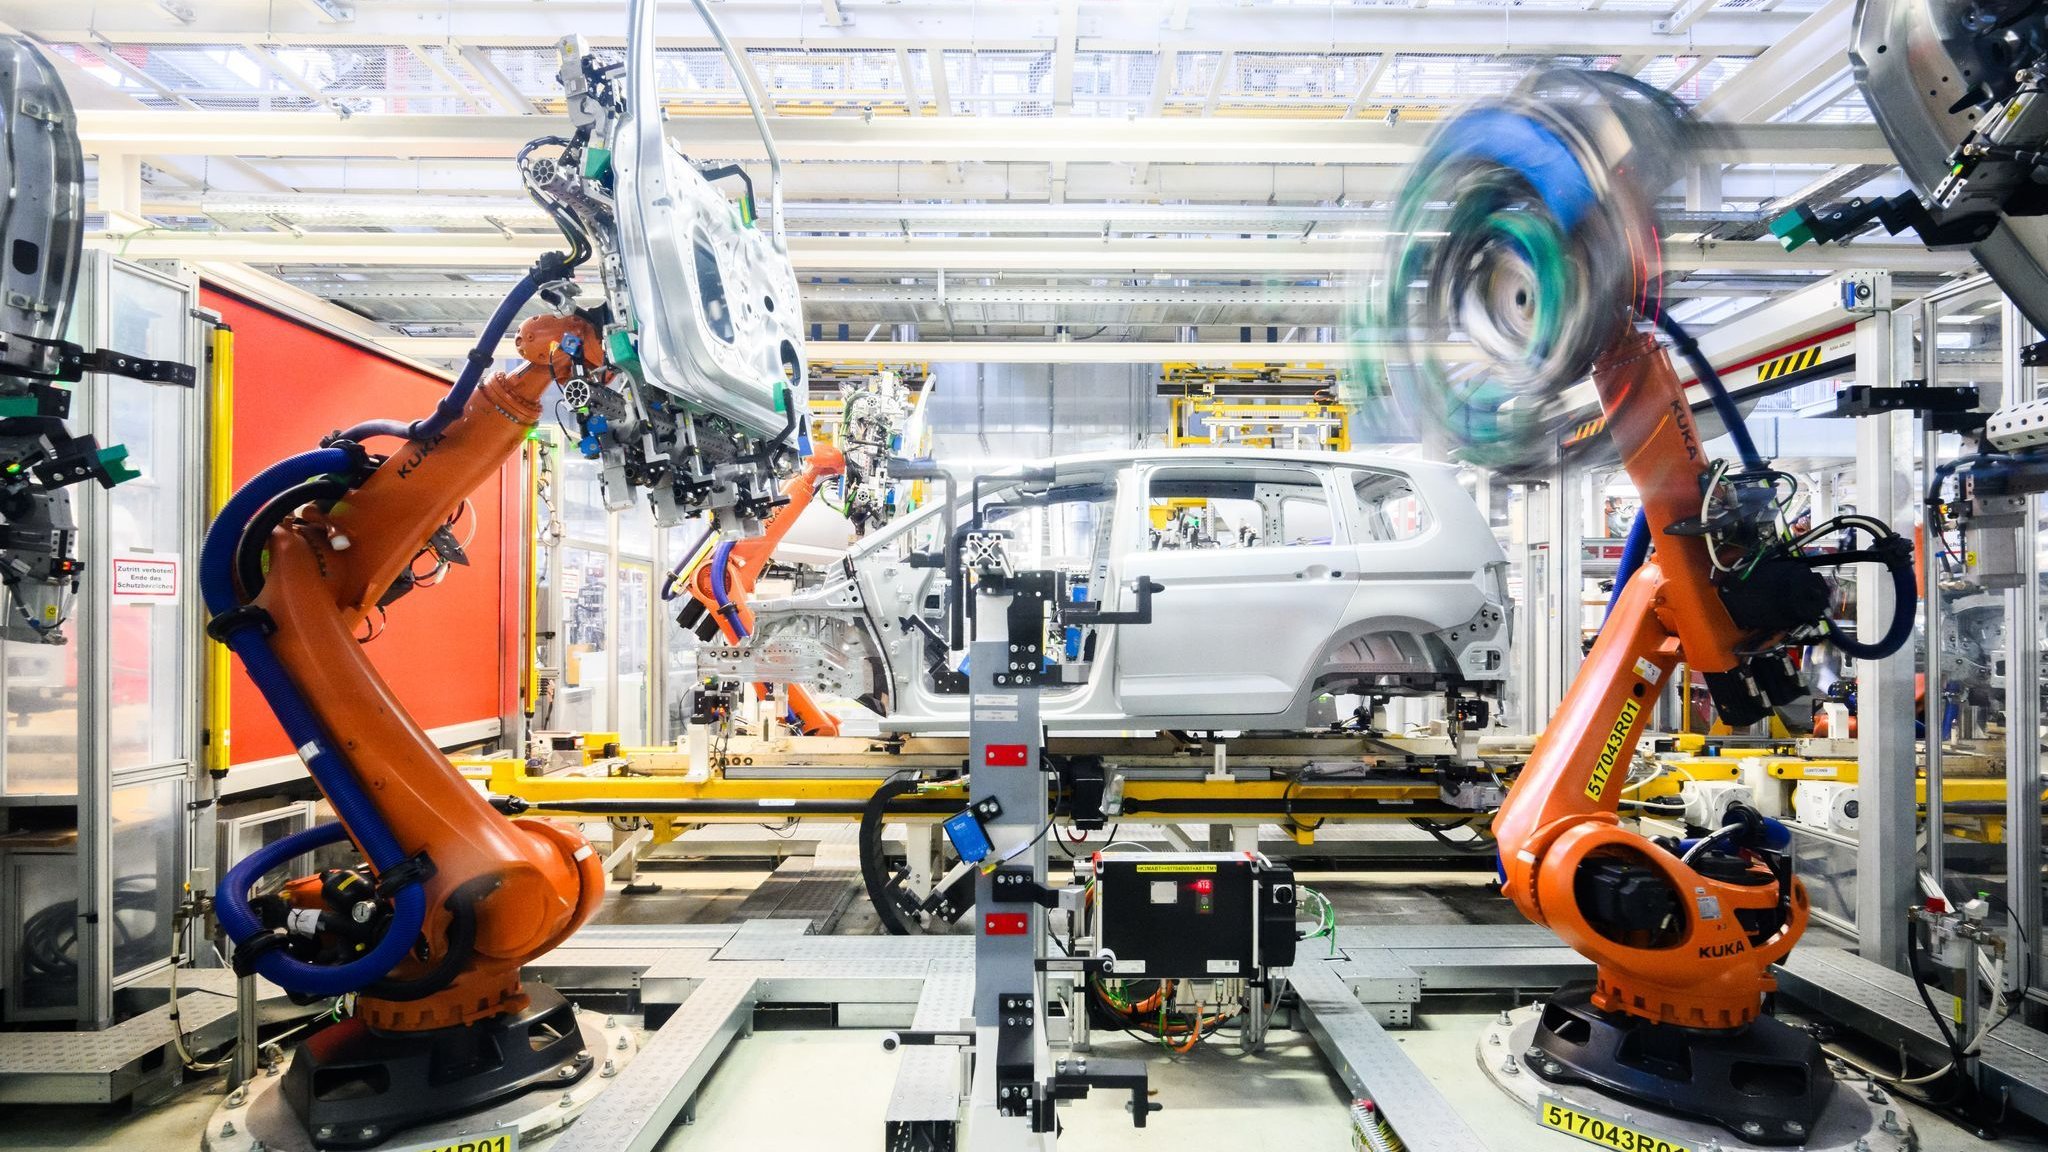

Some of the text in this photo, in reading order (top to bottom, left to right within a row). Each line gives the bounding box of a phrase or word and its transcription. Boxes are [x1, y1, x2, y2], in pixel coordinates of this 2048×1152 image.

[1671, 400, 1697, 460] KUKA
[397, 434, 447, 479] KUKA
[1587, 702, 1639, 796] 517043R01
[1699, 940, 1745, 958] KUKA
[1549, 1106, 1686, 1152] 517043R0
